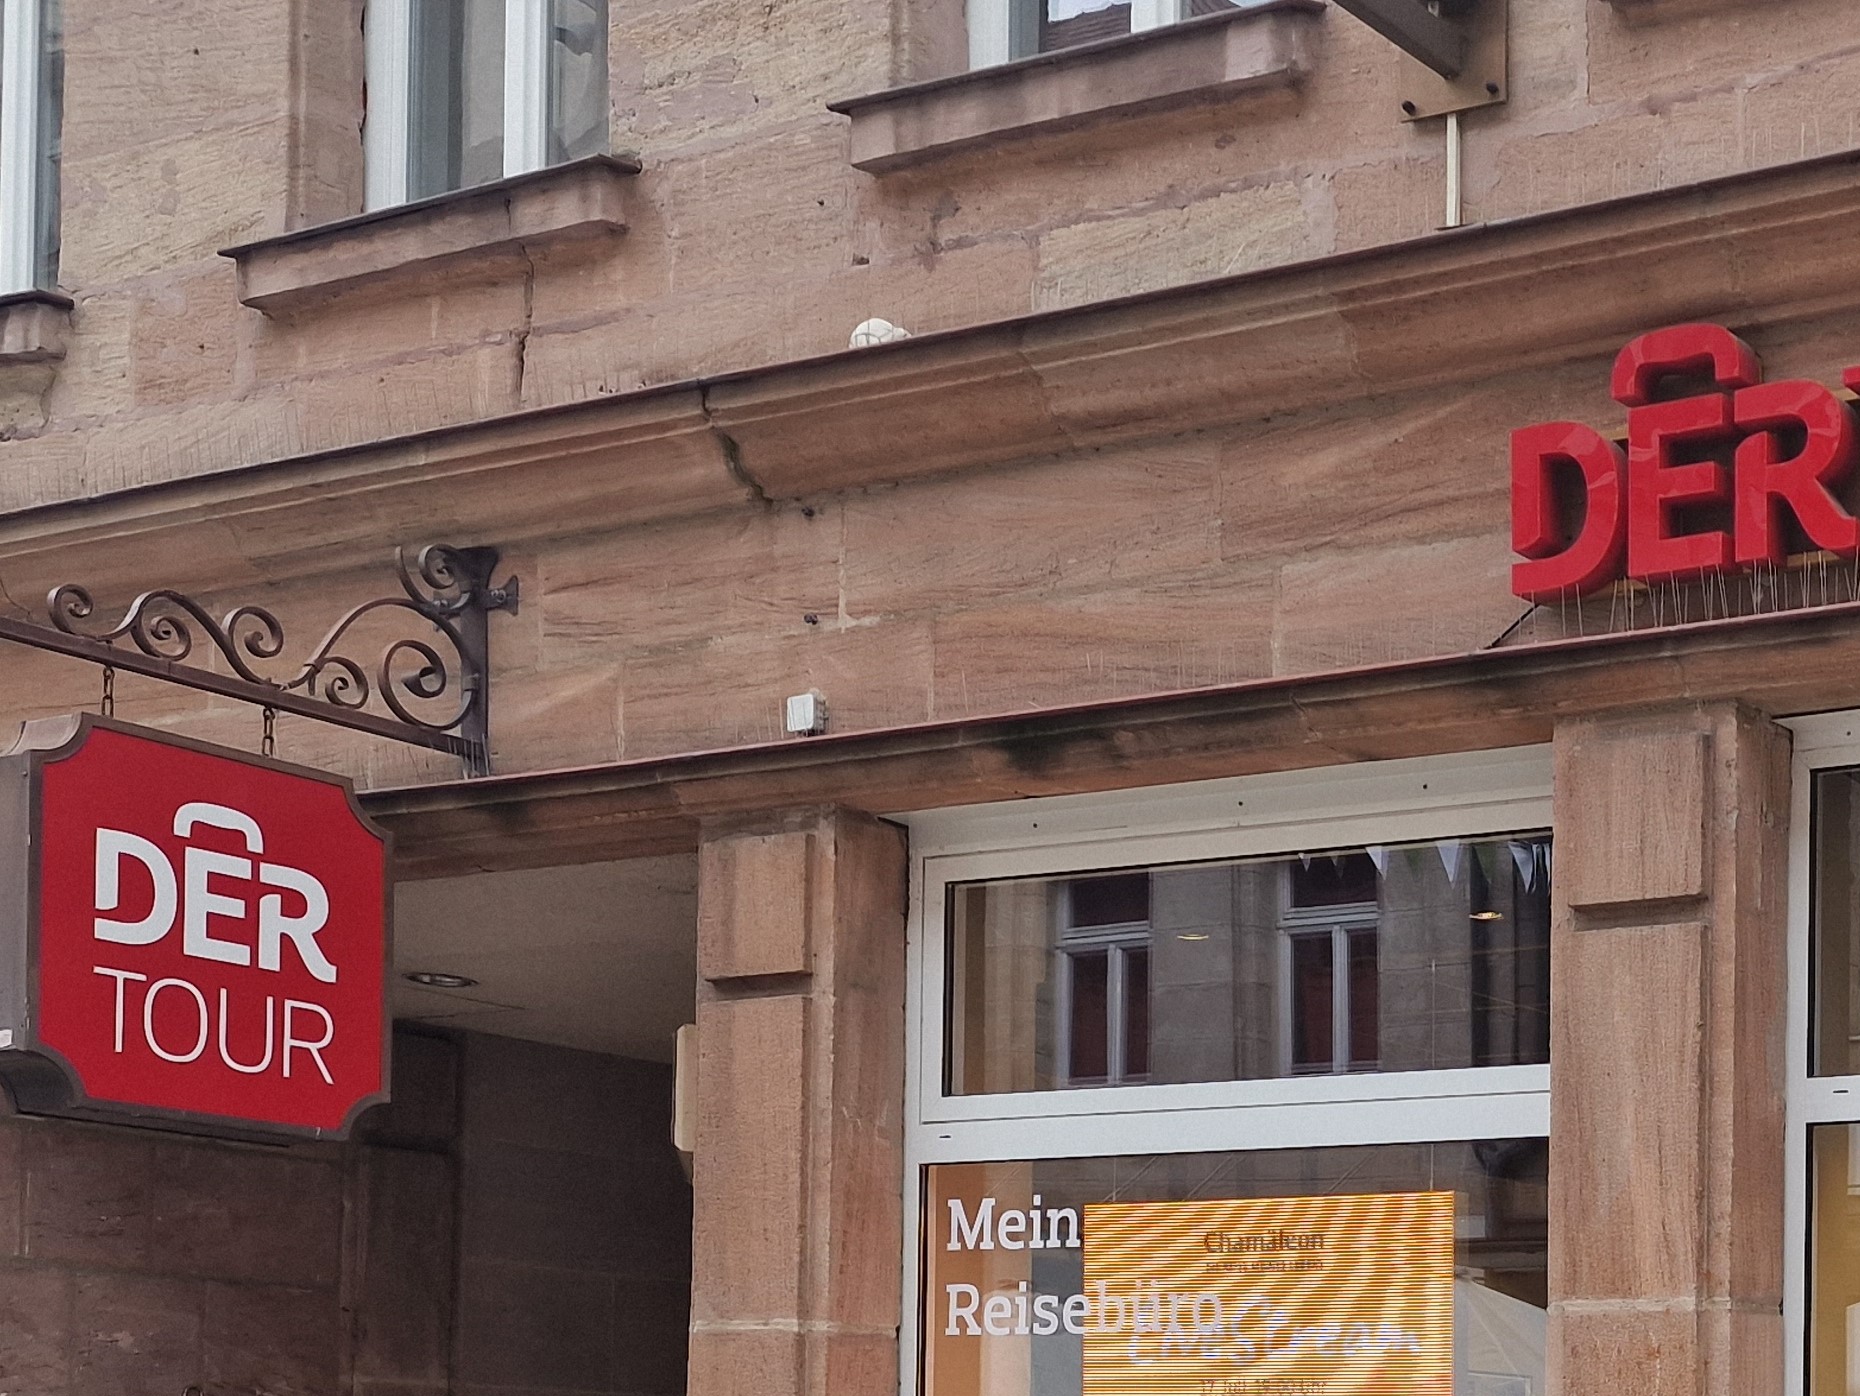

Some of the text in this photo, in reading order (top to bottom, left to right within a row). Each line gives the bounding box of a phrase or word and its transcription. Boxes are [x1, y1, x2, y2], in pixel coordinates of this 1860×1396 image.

[94, 802, 337, 983] DER
[93, 966, 335, 1084] TOUR
[947, 1195, 1081, 1251] Mein
[944, 1280, 1223, 1336] Reisebüro
